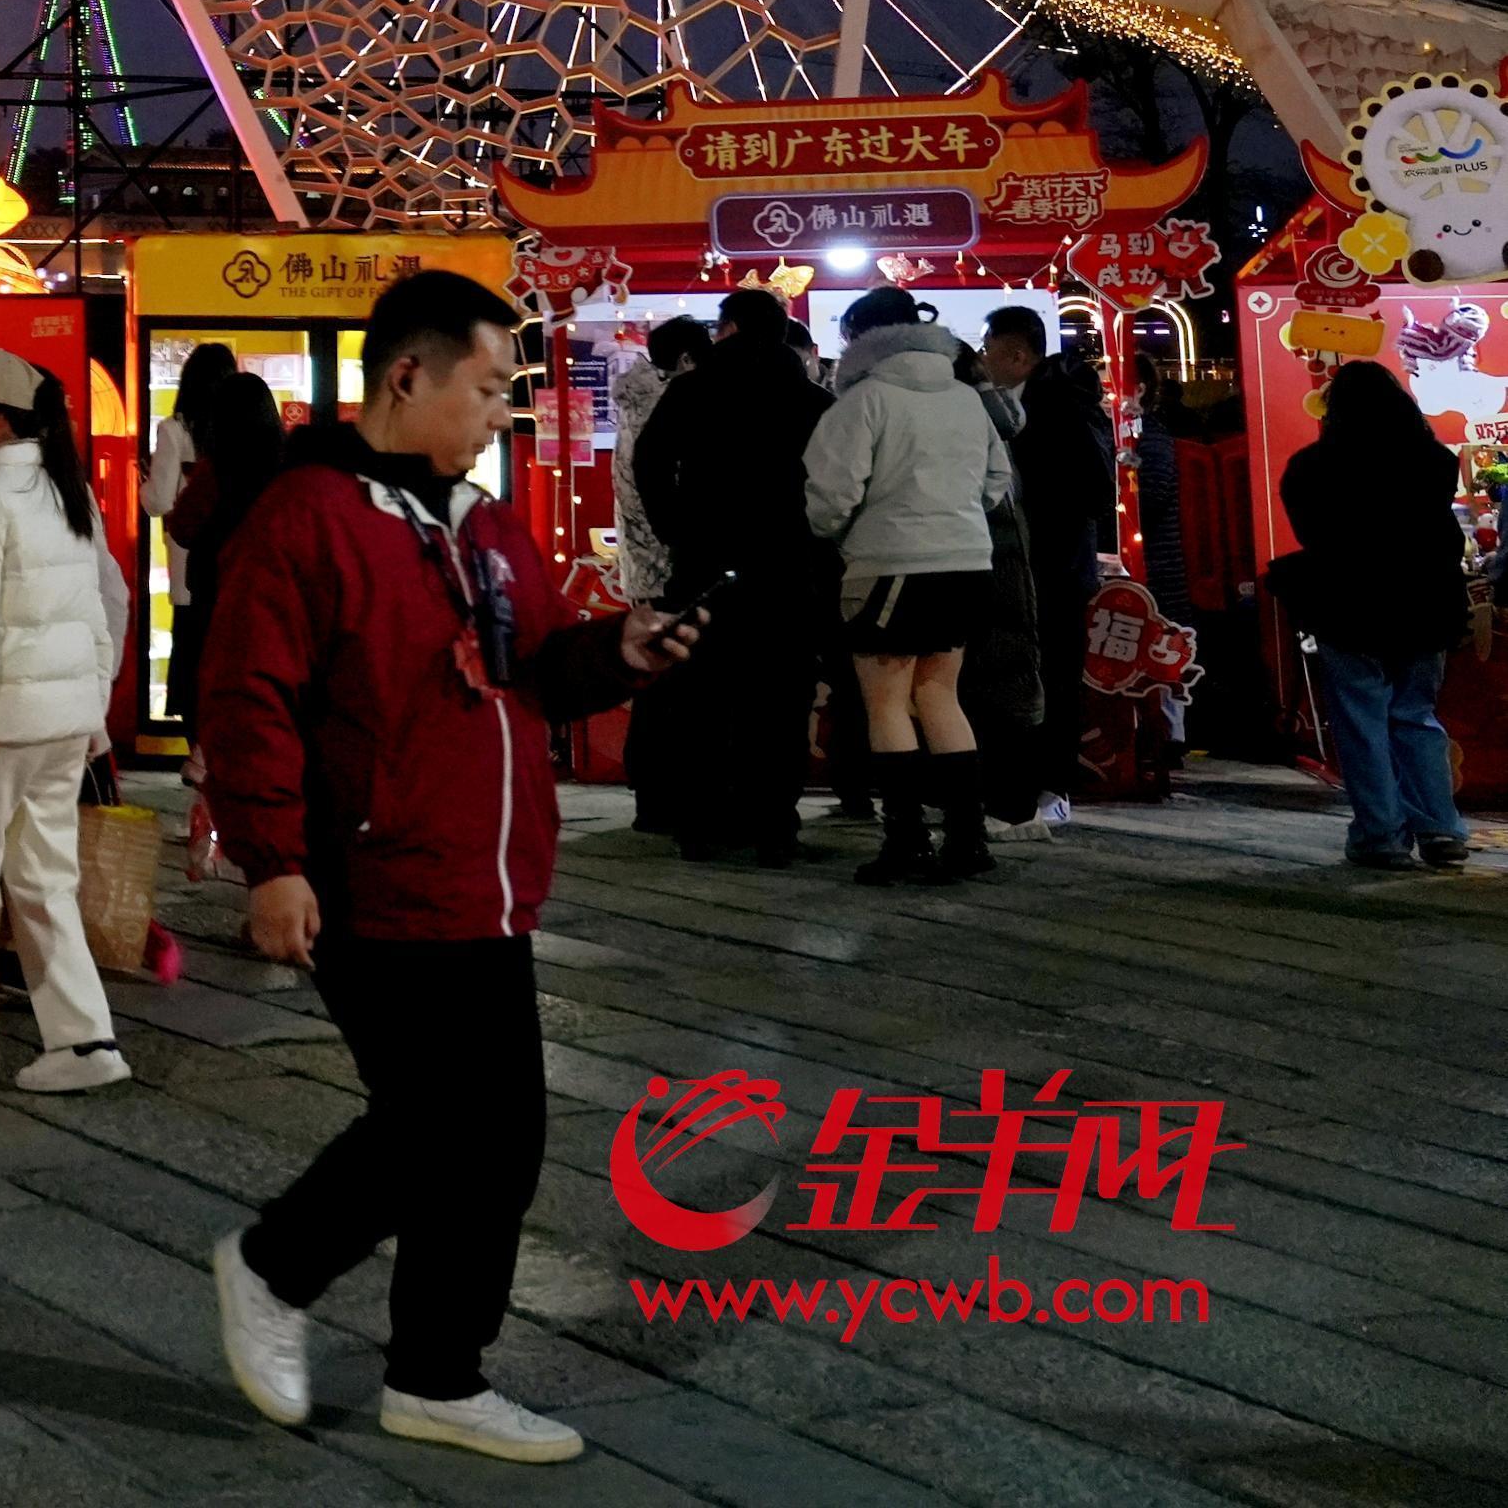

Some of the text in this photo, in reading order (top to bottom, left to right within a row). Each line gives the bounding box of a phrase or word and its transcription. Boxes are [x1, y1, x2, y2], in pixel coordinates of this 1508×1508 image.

[701, 123, 978, 170] 请到广东过大年
[1455, 161, 1488, 173] PLUS
[990, 175, 1104, 206] 广货行天下
[997, 197, 1098, 226] 春季行动
[1098, 232, 1154, 258] 马到
[1098, 264, 1157, 287] 成功
[279, 287, 306, 298] THE
[310, 287, 343, 298] GIFT
[347, 288, 365, 298] OF
[1087, 607, 1145, 662] 福
